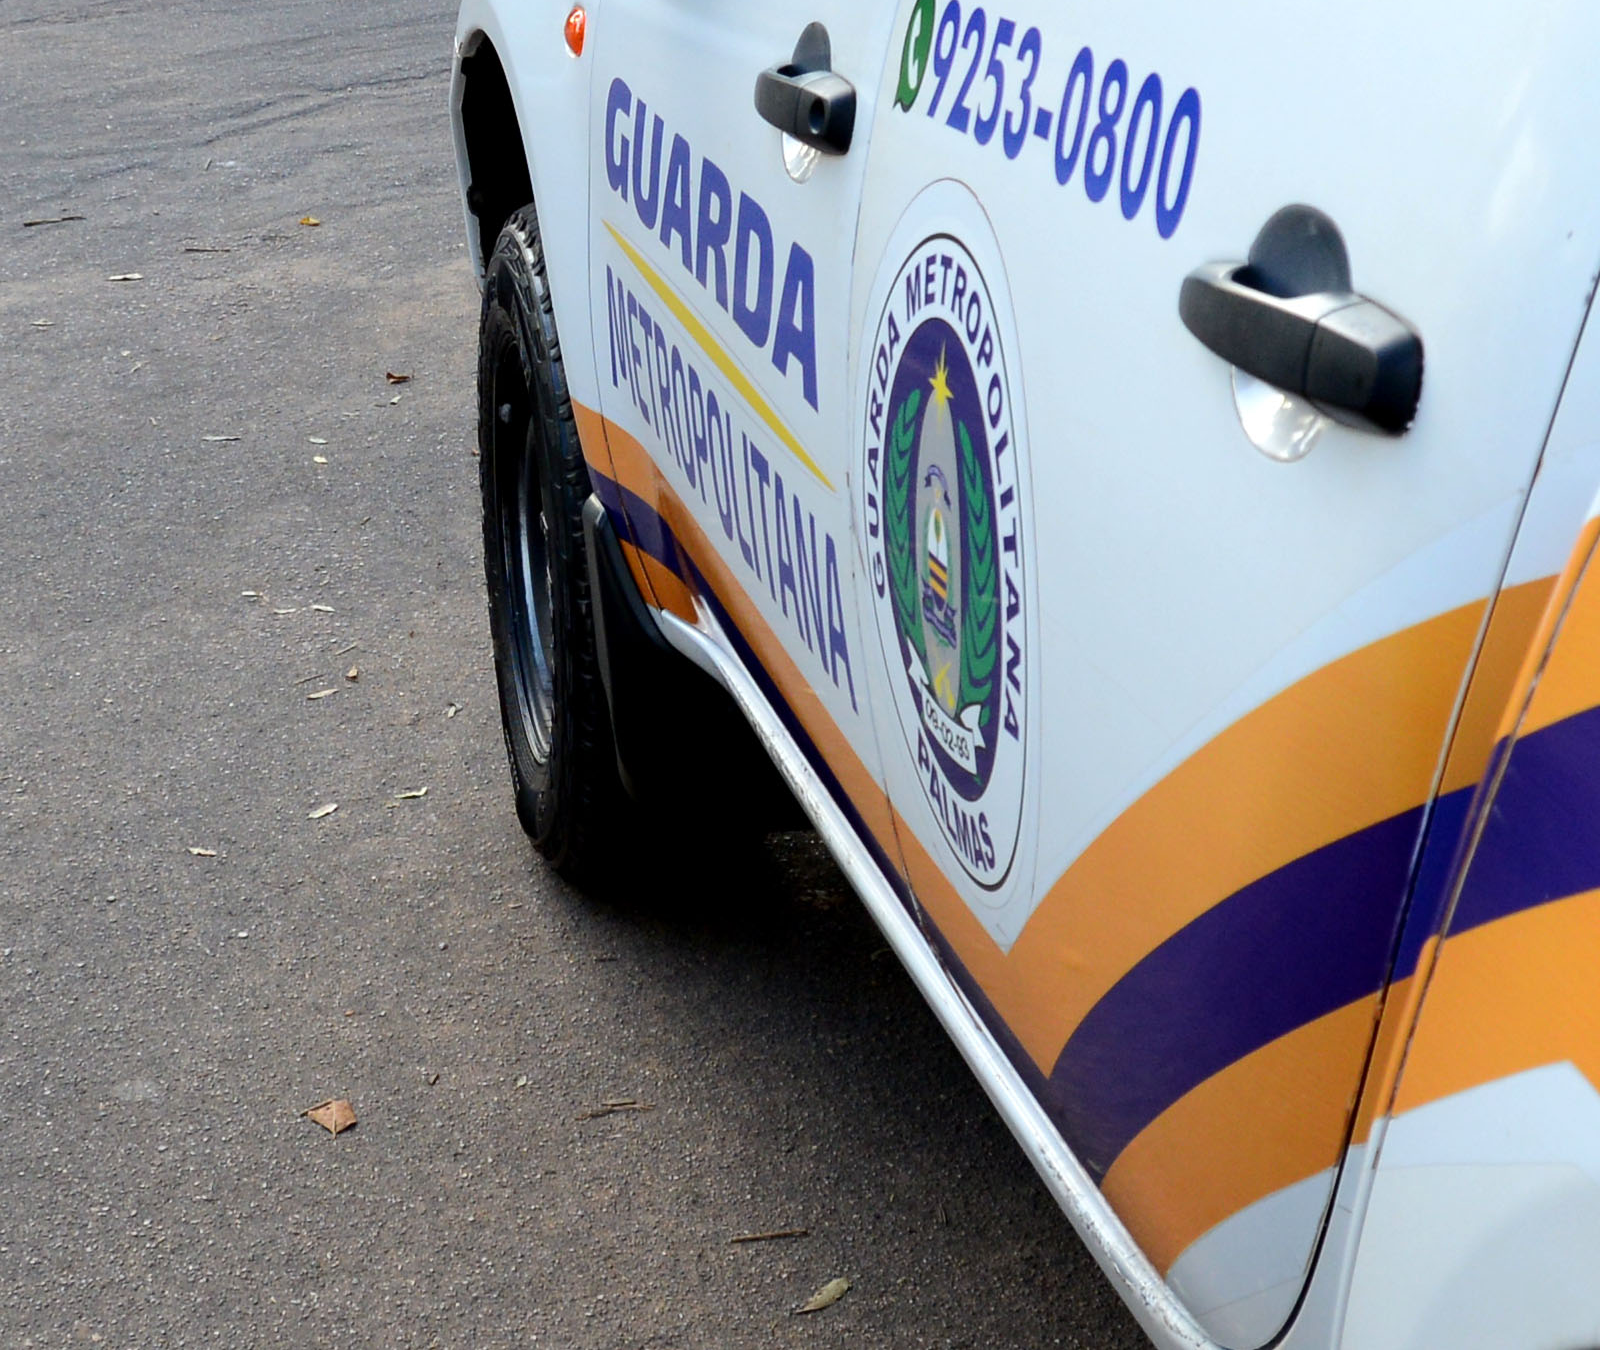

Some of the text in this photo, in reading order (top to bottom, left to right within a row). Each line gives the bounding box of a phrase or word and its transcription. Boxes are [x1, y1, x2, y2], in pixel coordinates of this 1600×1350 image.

[604, 77, 820, 414] GUARDA
[605, 264, 859, 716] METROPOLITANA
[866, 252, 1022, 742] GUARDA METROPOLITANA
[917, 726, 996, 873] PALMAS
